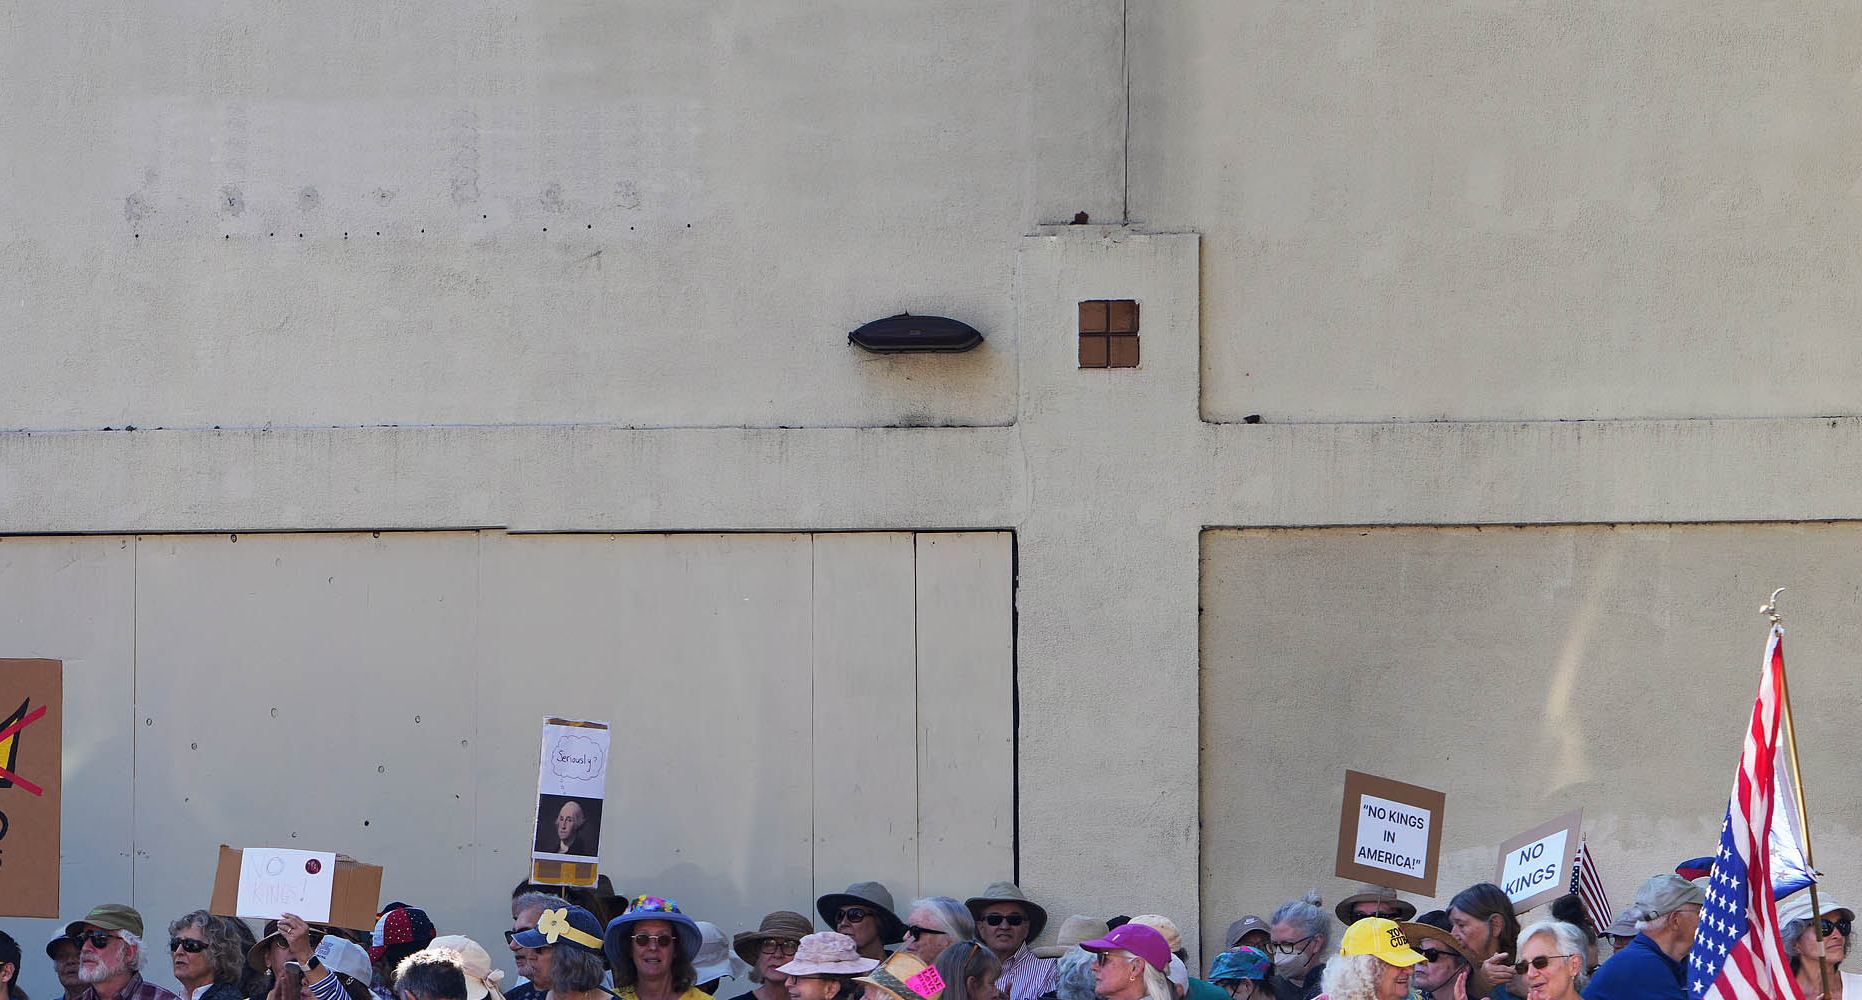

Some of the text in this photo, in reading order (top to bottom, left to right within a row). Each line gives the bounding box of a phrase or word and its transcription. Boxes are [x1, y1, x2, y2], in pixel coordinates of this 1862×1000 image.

[557, 749, 598, 773] Seriously?
[1389, 810, 1424, 829] KINGS
[1383, 830, 1396, 843] IN
[1519, 842, 1544, 865] NO
[1505, 863, 1556, 896] KINGS
[927, 967, 944, 988] RISE
